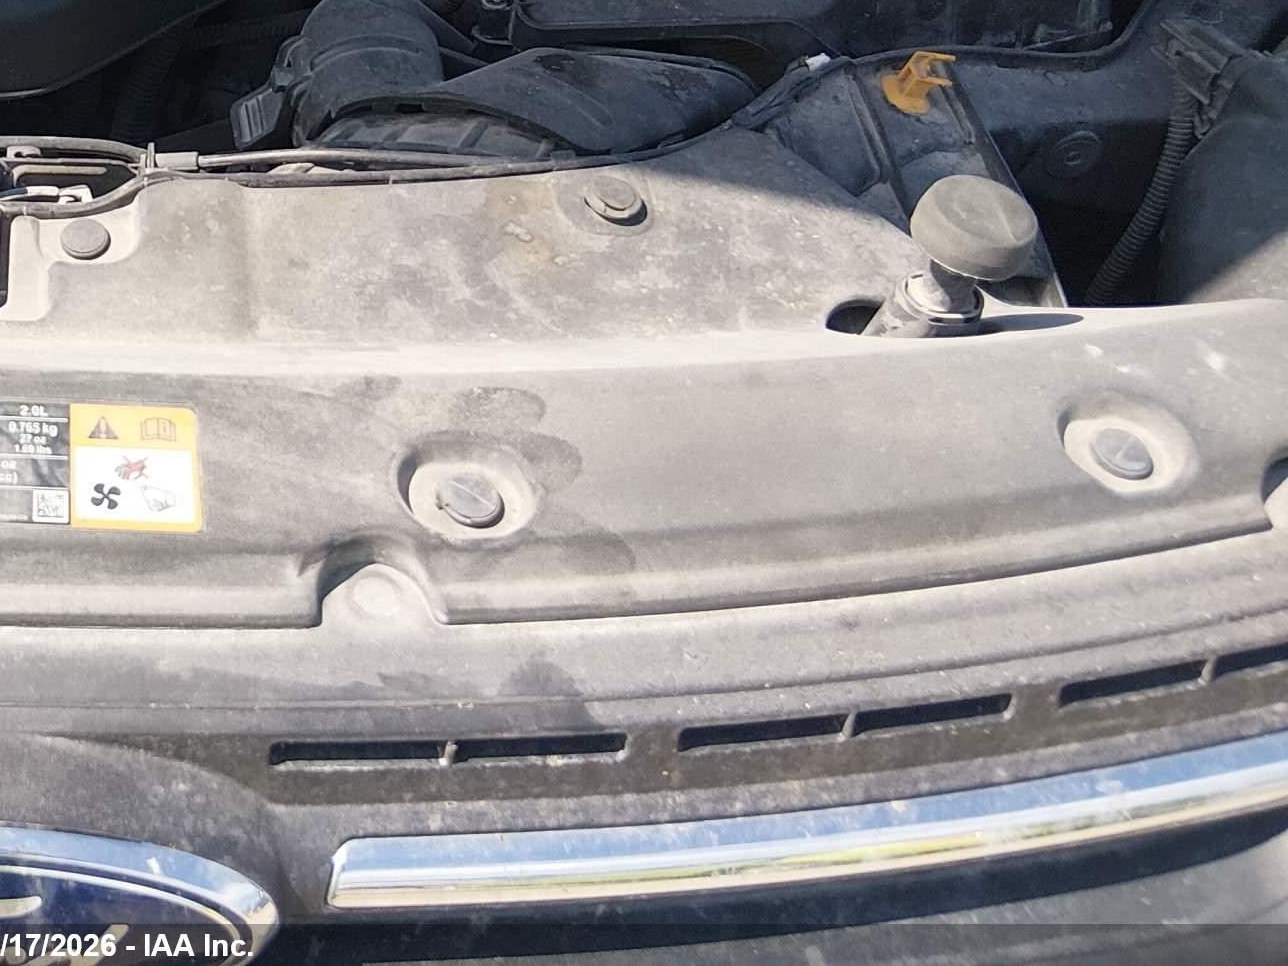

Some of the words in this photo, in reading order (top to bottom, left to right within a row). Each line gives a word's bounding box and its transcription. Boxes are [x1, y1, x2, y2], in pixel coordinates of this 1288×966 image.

[19, 405, 49, 417] 2.0L
[42, 422, 58, 438] kg
[1, 459, 17, 469] oz
